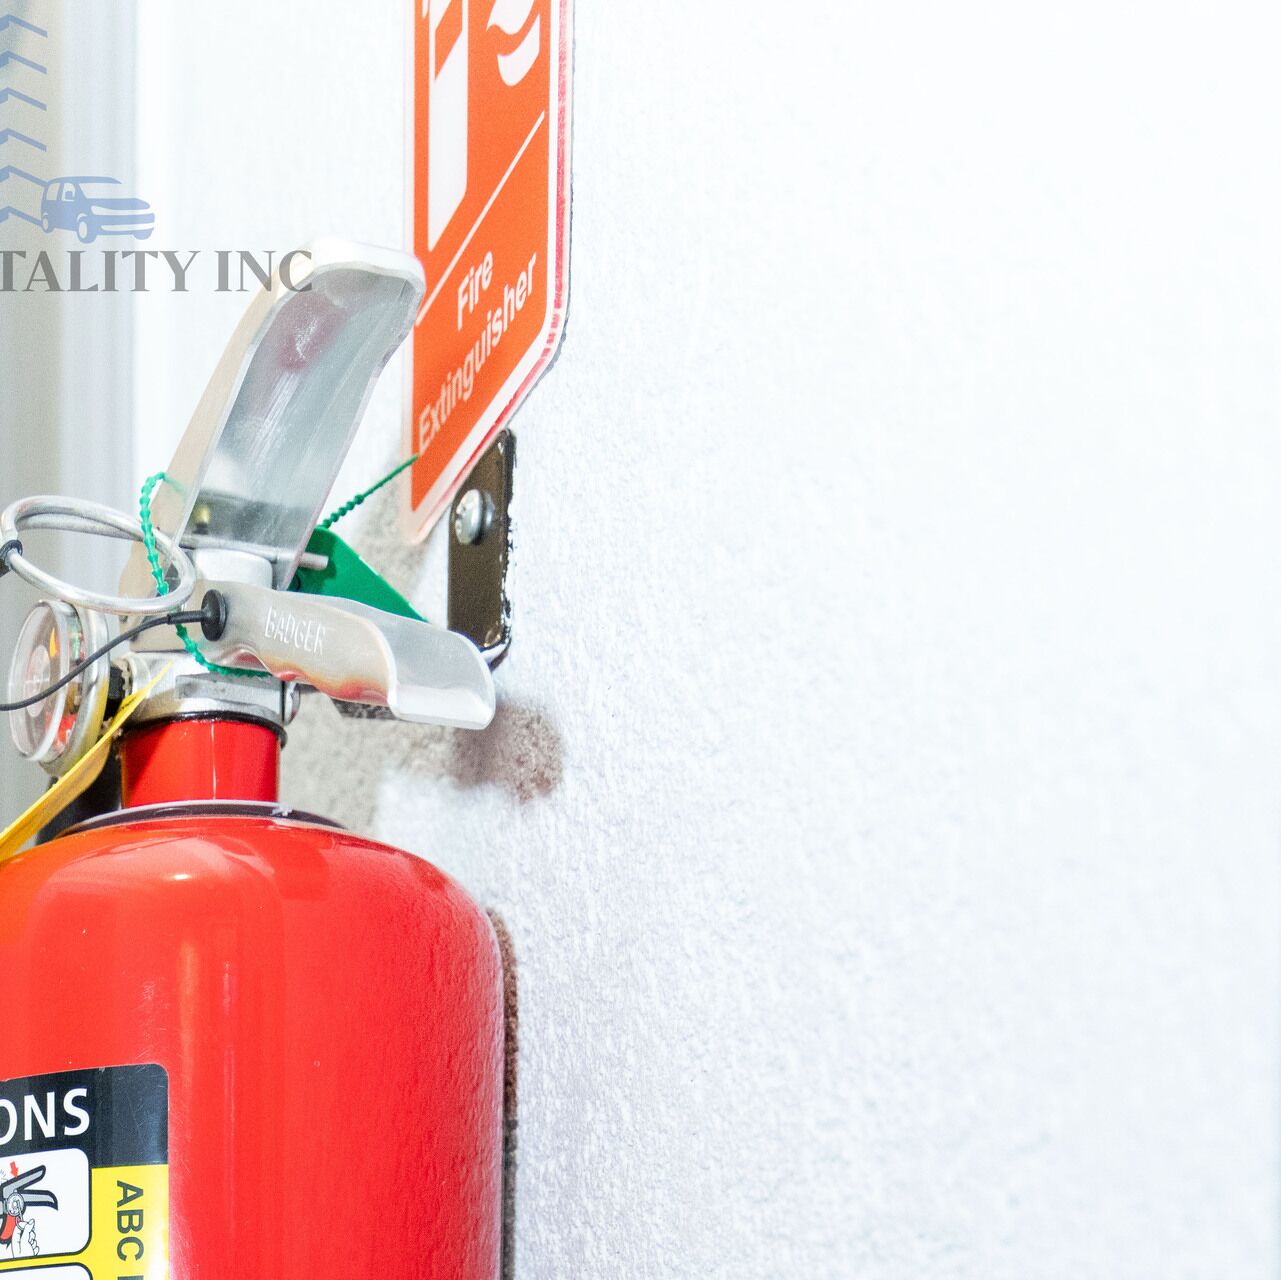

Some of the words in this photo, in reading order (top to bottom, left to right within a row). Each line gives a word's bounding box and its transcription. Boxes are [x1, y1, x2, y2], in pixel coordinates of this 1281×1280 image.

[456, 250, 494, 332] Fire
[419, 251, 537, 457] Extinguisher
[264, 605, 327, 657] BADGER
[116, 1180, 144, 1262] ABC
